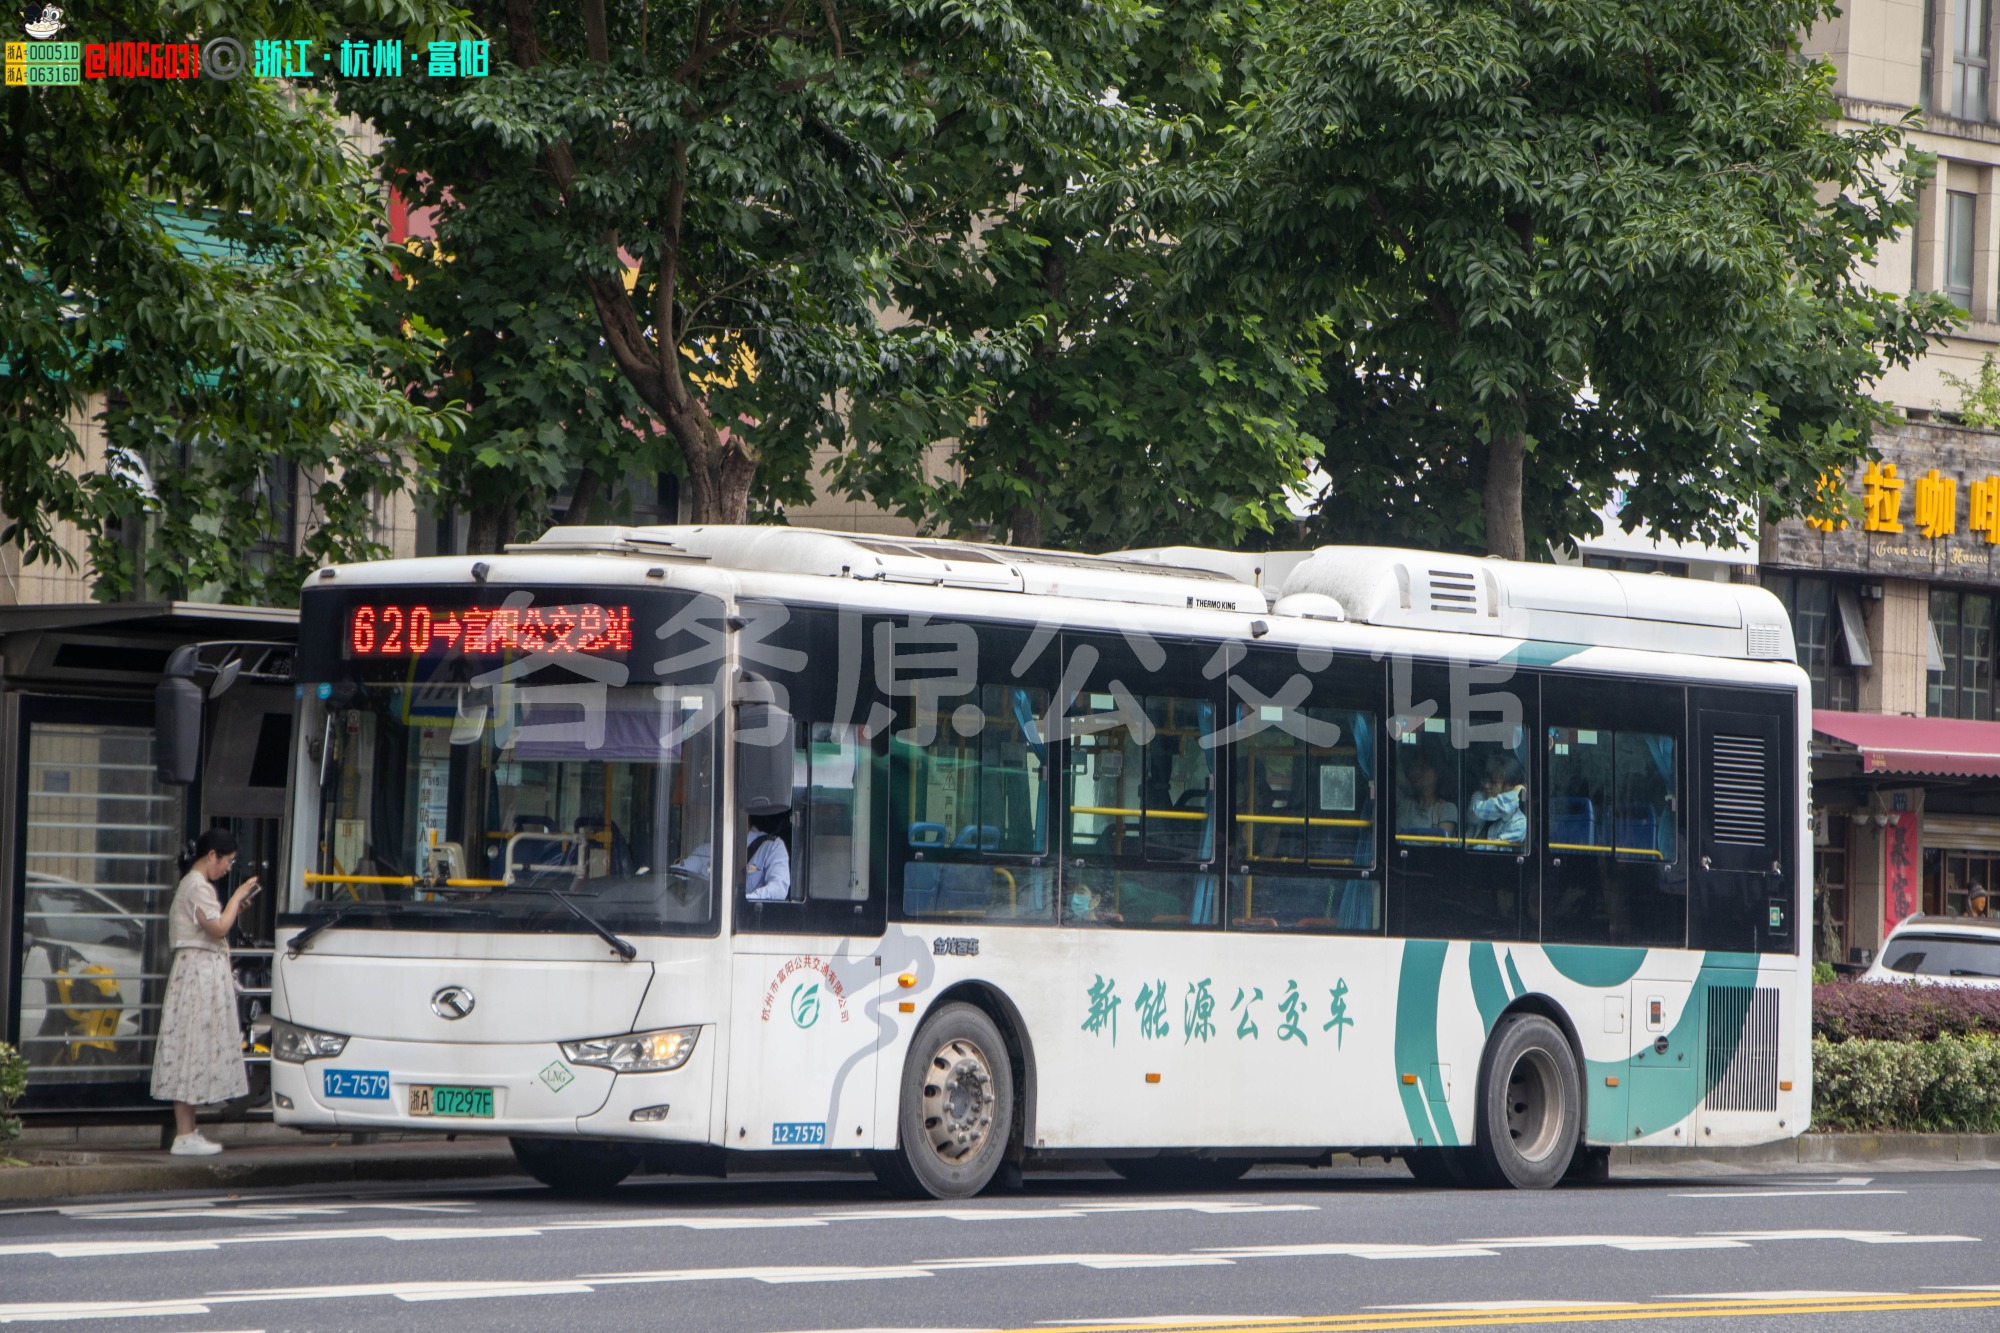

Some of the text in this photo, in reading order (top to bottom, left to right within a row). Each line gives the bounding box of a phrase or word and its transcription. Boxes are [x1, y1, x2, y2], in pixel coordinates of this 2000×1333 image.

[1806, 460, 2000, 544] 拉咖啡
[1196, 599, 1236, 610] THERMO KING
[353, 606, 634, 653] 620 富阳公交总站
[933, 937, 979, 956] 金龙客车
[761, 954, 850, 1023] 杭州市富阳公共交通有限公司
[1081, 973, 1354, 1052] 新能源公交车
[325, 1073, 389, 1096] 12-7579
[774, 1125, 823, 1142] 12-7579
